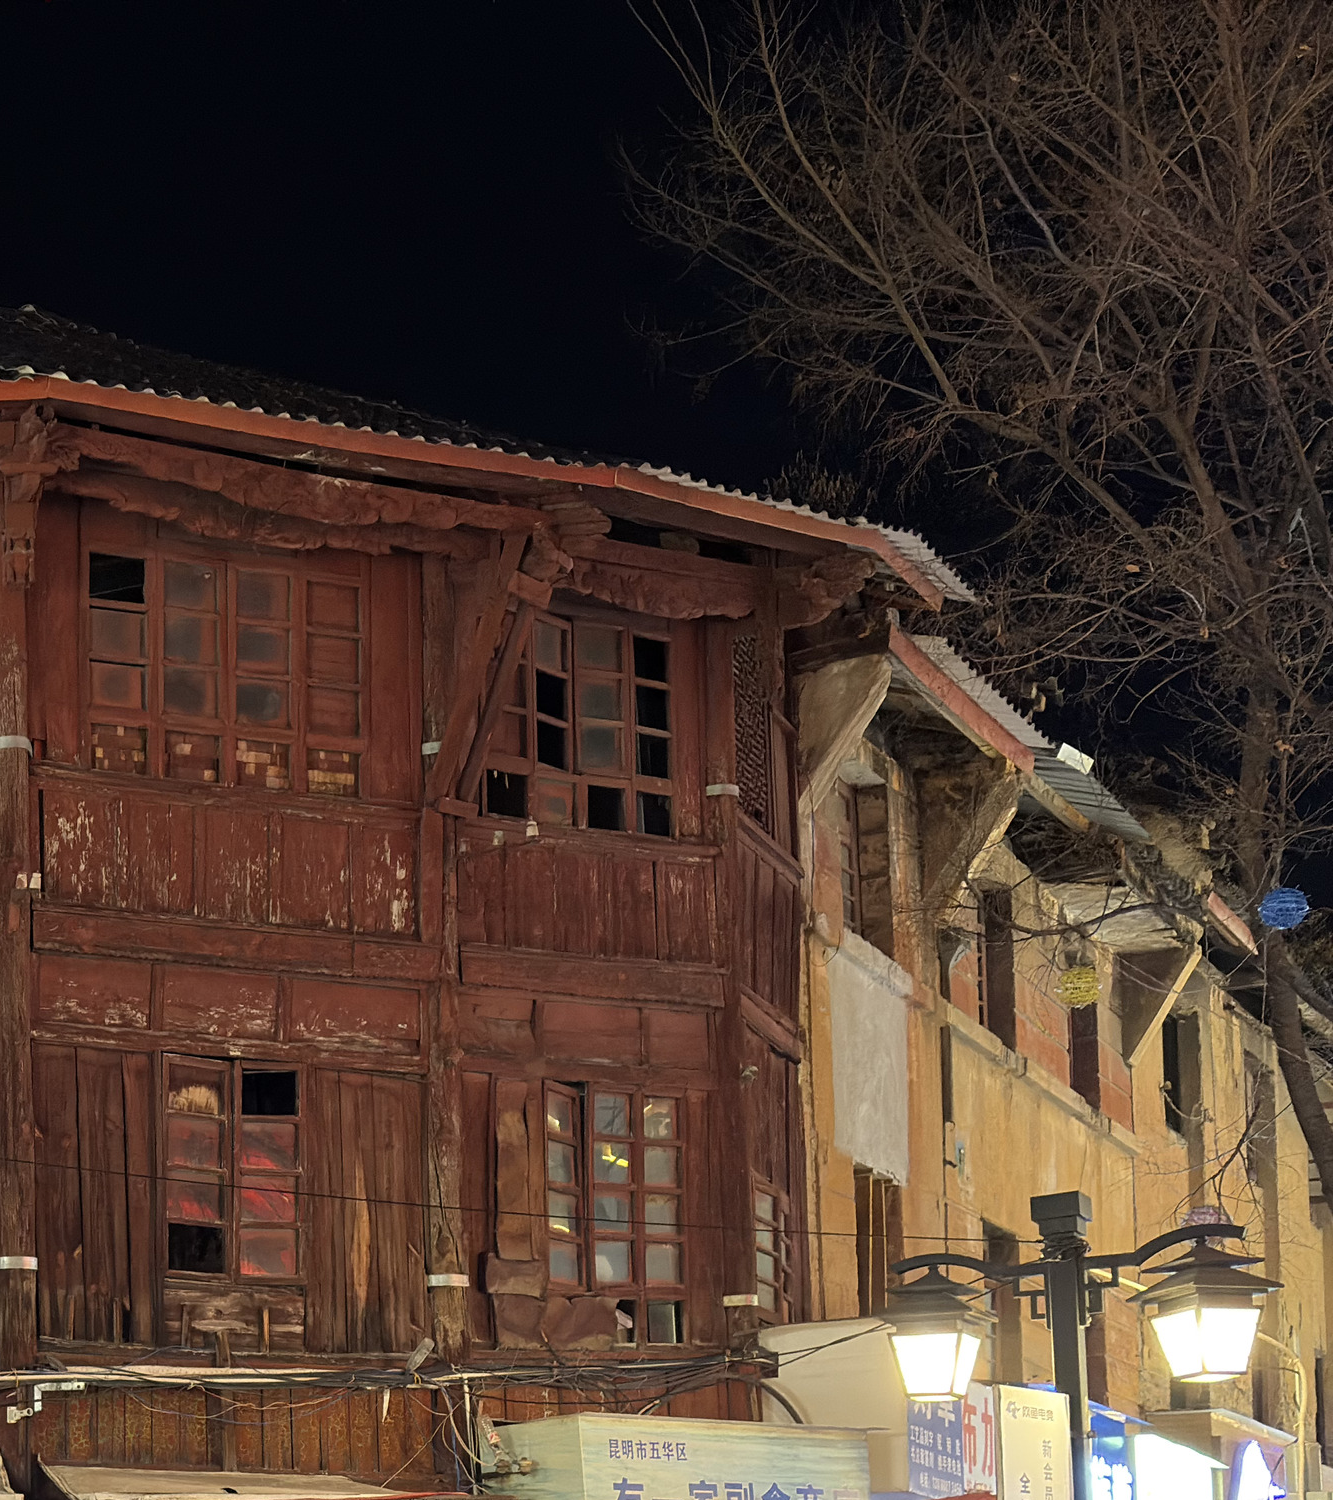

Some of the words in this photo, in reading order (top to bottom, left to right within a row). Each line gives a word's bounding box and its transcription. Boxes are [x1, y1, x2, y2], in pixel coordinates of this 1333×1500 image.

[608, 1438, 688, 1462] 昆明市五华区
